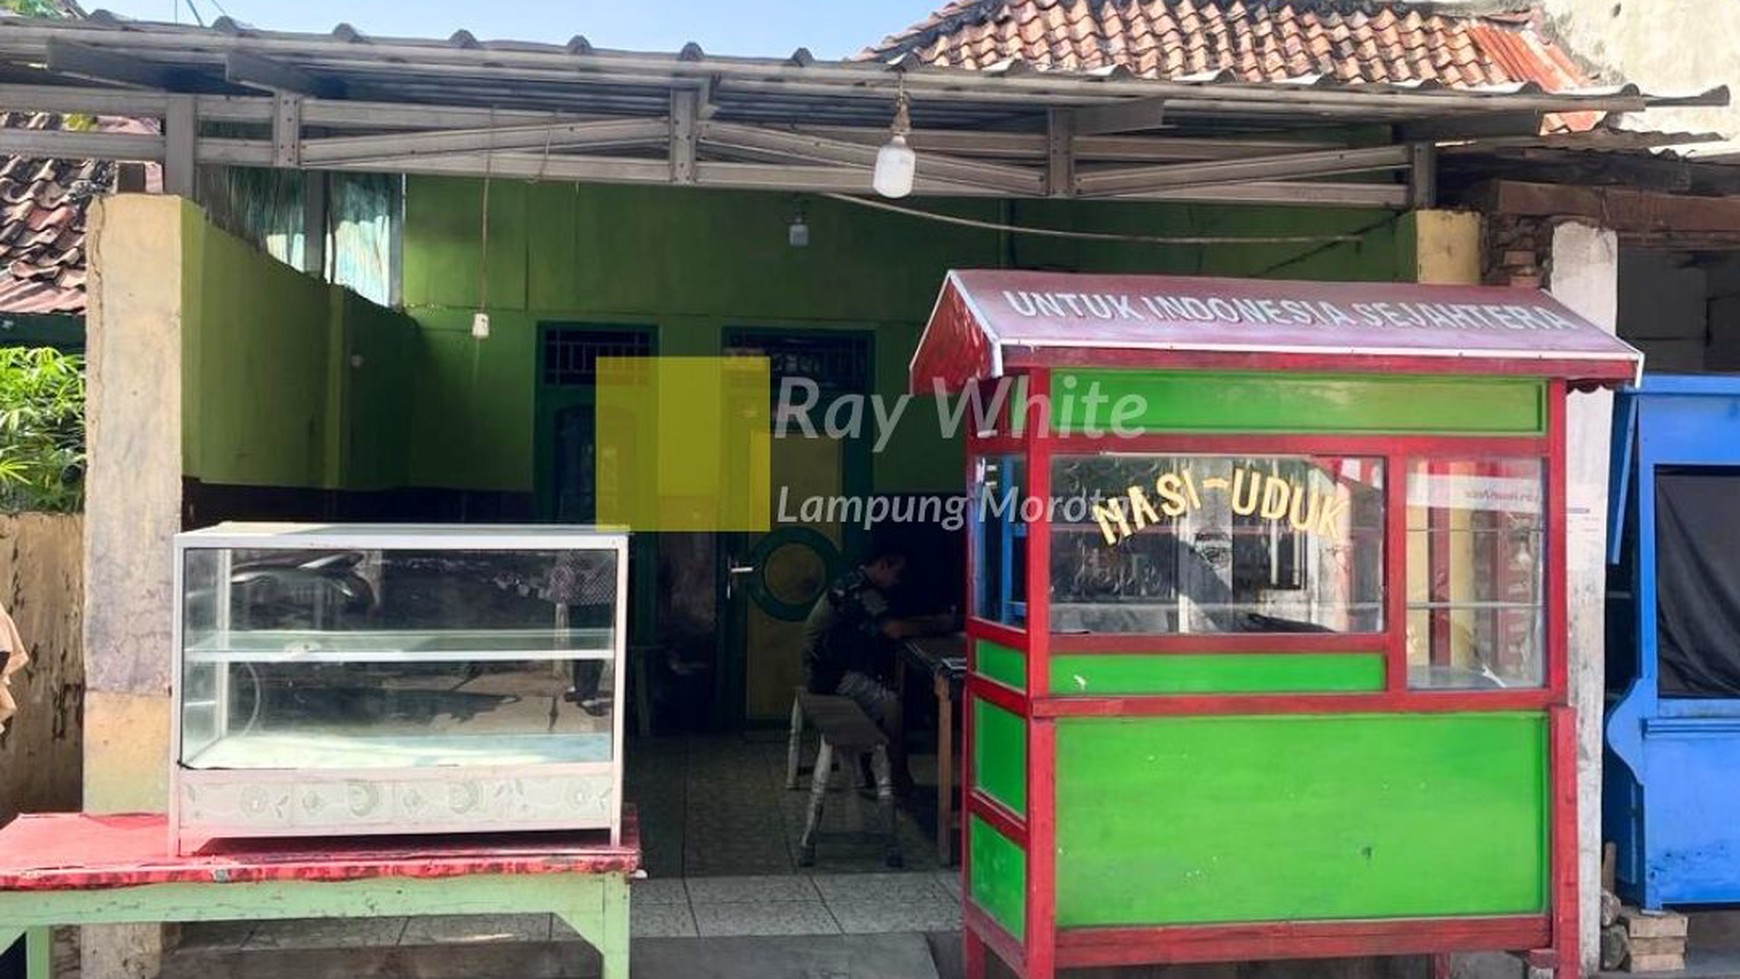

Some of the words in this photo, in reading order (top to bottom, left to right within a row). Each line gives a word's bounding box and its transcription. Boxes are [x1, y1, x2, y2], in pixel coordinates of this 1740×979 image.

[1003, 290, 1142, 319] UNTUK
[1142, 296, 1352, 324] INDONESIA
[1353, 302, 1577, 331] SEJAHTERA
